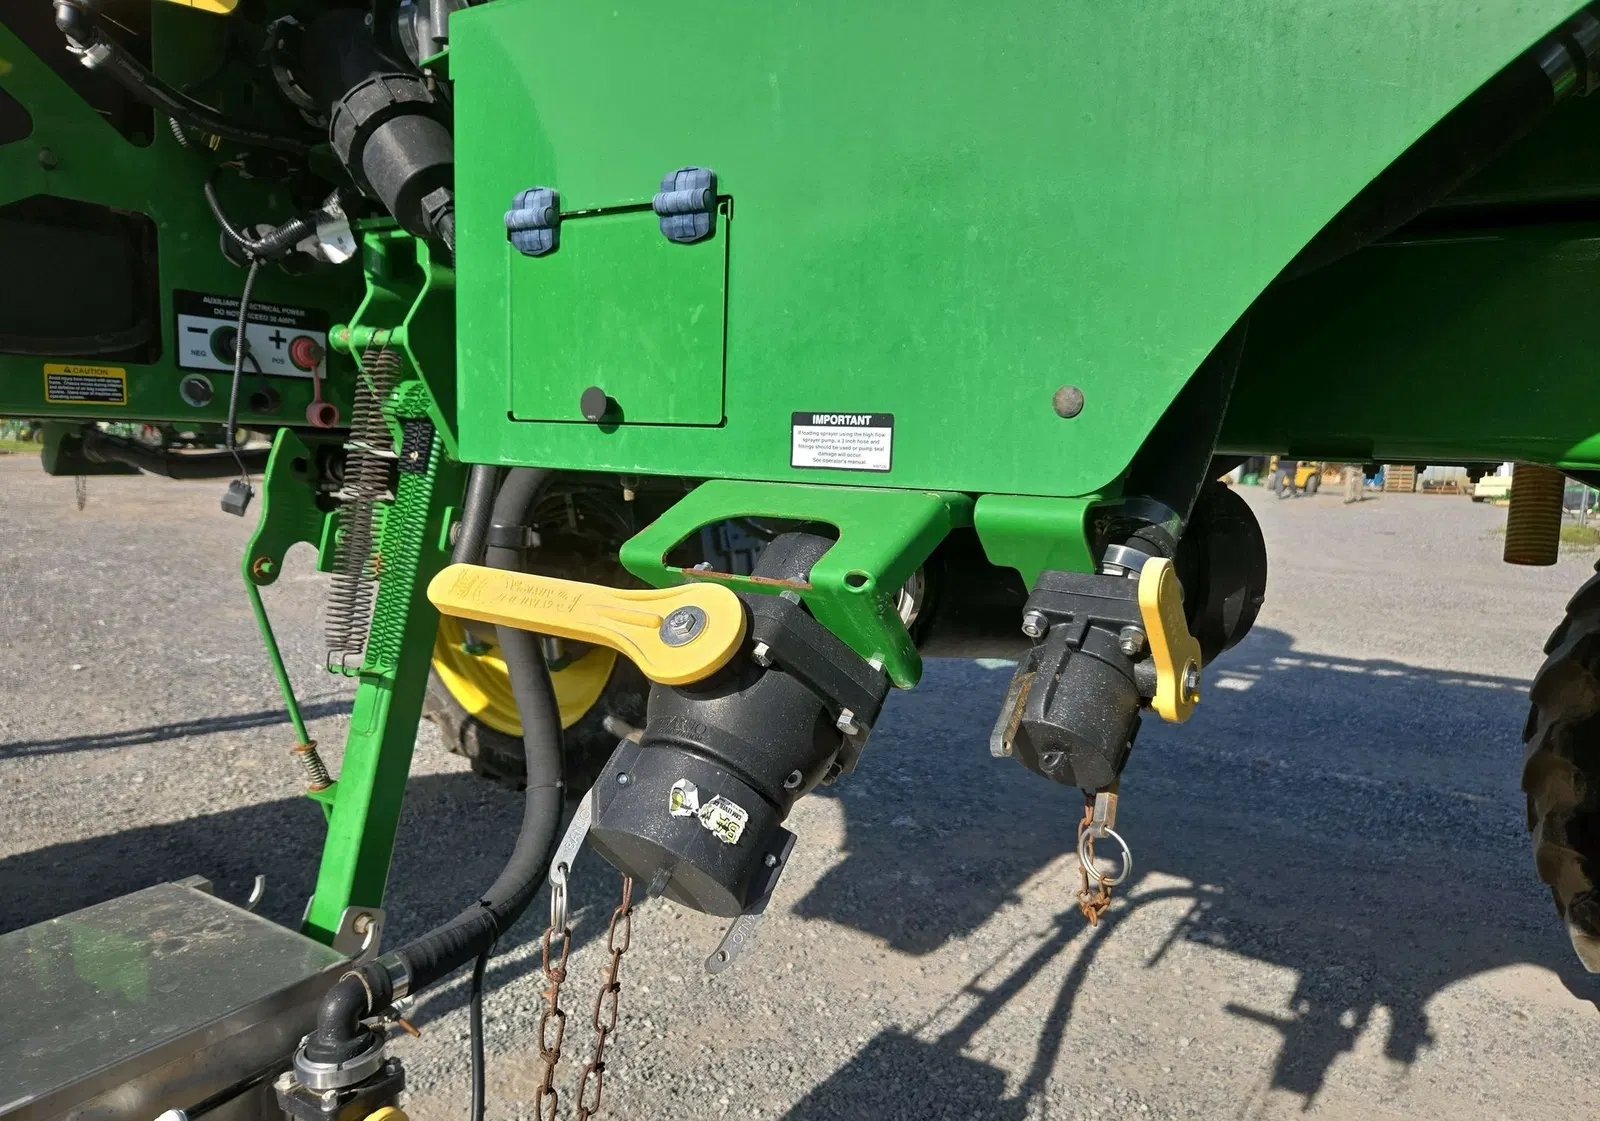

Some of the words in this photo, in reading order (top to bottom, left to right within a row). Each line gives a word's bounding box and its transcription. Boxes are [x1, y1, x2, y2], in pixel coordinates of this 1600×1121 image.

[203, 296, 239, 307] AUXILIARY
[190, 349, 207, 357] NEG
[271, 357, 285, 365] POS
[73, 367, 108, 375] CAUTION
[812, 414, 872, 425] IMPORTANT
[565, 808, 591, 850] BANJO
